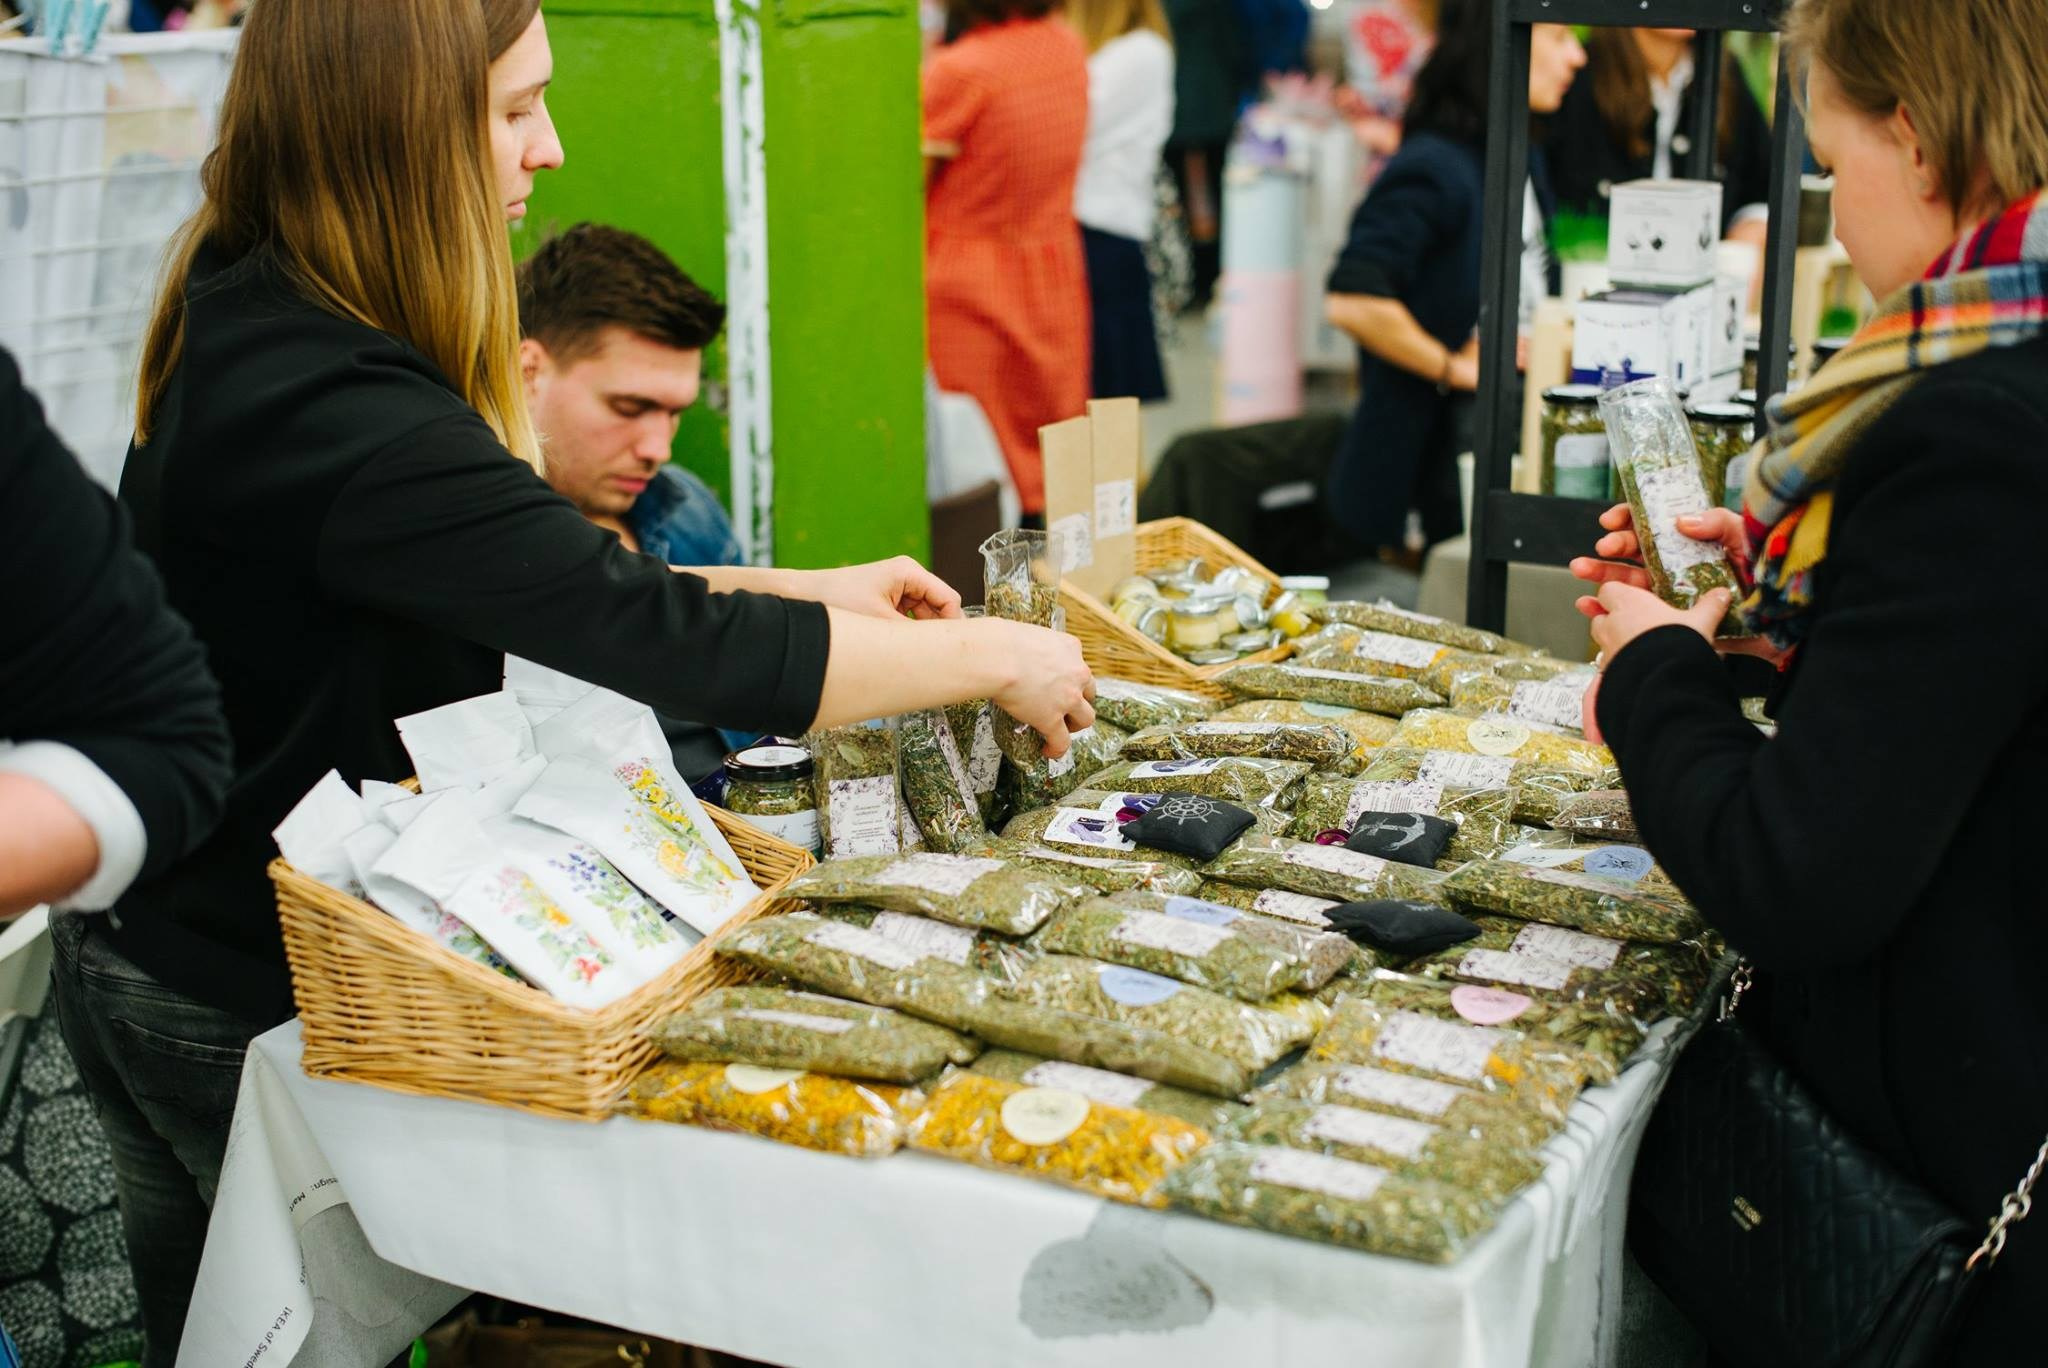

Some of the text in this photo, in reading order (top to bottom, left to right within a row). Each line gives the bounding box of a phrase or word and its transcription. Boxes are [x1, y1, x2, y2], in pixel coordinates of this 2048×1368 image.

[243, 1306, 293, 1368] IKEA of Swed
